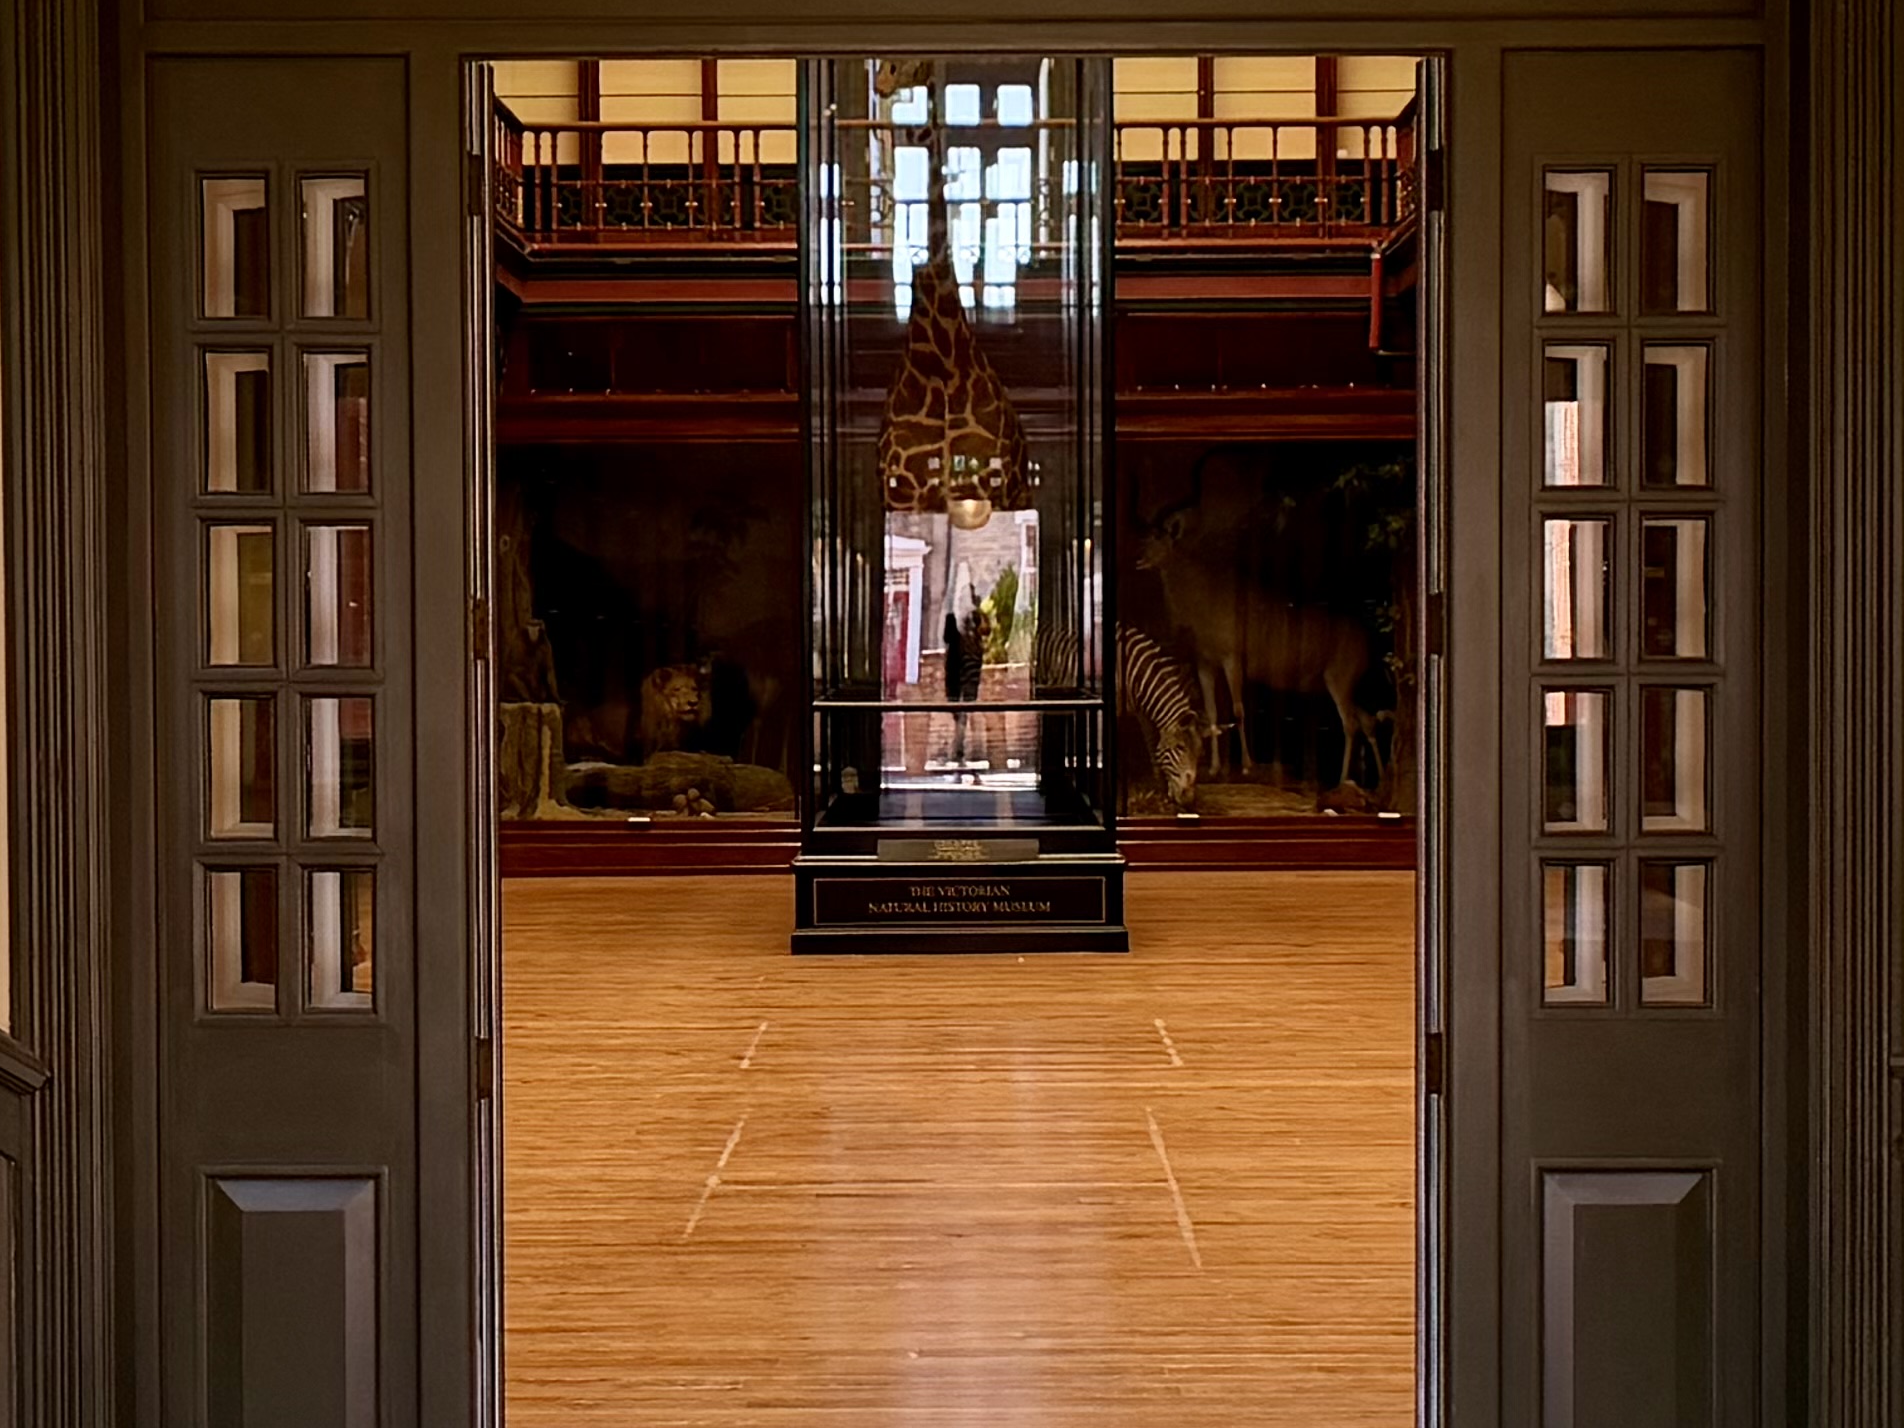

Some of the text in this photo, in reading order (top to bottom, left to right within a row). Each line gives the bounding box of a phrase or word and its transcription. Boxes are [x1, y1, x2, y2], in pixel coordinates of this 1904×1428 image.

[909, 884, 1011, 897] THE VICTORIAN
[868, 900, 1051, 914] NATURAL HISTORY MUSEUM
